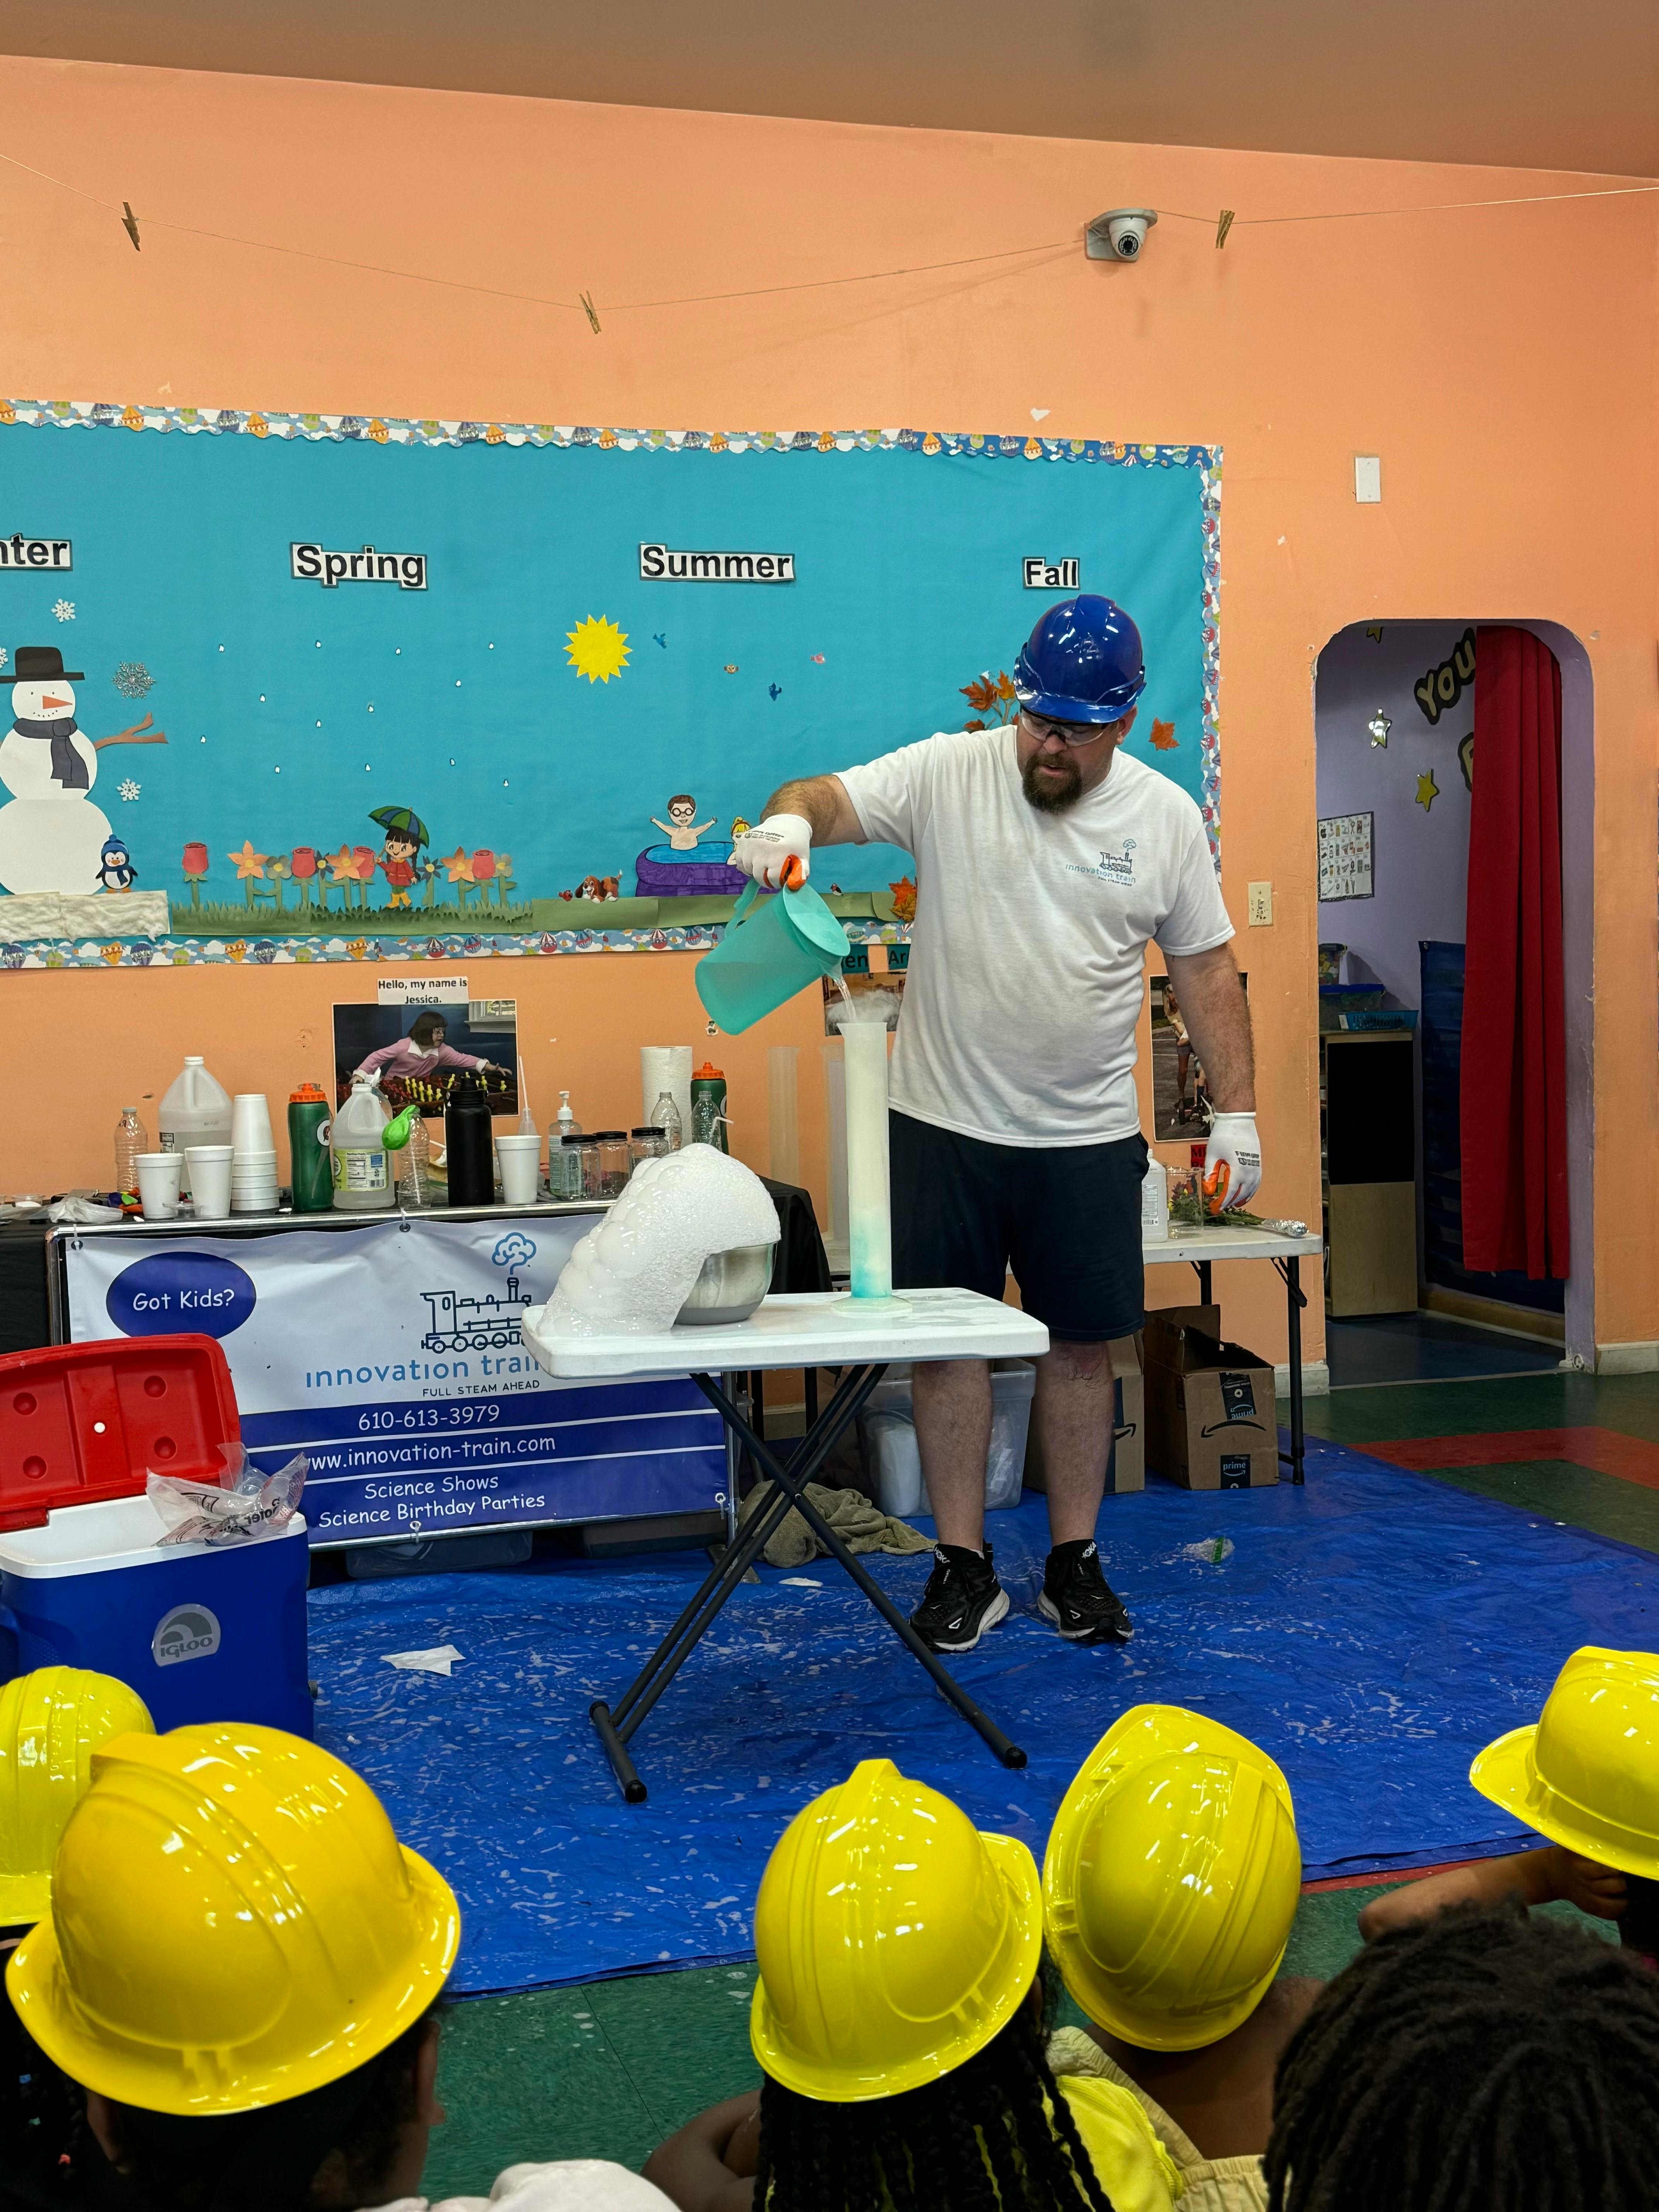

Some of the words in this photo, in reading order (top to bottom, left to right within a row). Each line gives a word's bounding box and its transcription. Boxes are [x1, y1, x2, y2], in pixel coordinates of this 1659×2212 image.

[297, 545, 423, 587] Spring
[642, 546, 790, 578] Summer
[1026, 560, 1077, 586] Fall
[1065, 864, 1113, 878] innovation
[1116, 873, 1135, 883] train
[888, 950, 909, 965] Ar
[378, 980, 407, 990] Hello,
[410, 981, 426, 990] my
[429, 979, 457, 988] name
[460, 978, 467, 987] is
[405, 995, 442, 1004] Jessica.
[133, 1293, 172, 1311] Got
[180, 1288, 235, 1309] Kids?
[307, 1360, 468, 1388] innovation
[423, 1388, 452, 1397] FULL
[458, 1384, 497, 1394] STEAM
[503, 1380, 540, 1391] AHEAD
[359, 1404, 500, 1431] 610-613-3979
[308, 1437, 556, 1470] ww.innovation-train.com
[1223, 1462, 1246, 1471] prime
[364, 1483, 435, 1499] Science
[442, 1475, 499, 1492] Shows
[319, 1510, 391, 1527] Science
[397, 1501, 476, 1520] Birthday
[482, 1494, 545, 1511] Parties
[161, 1637, 213, 1658] IGLOO
